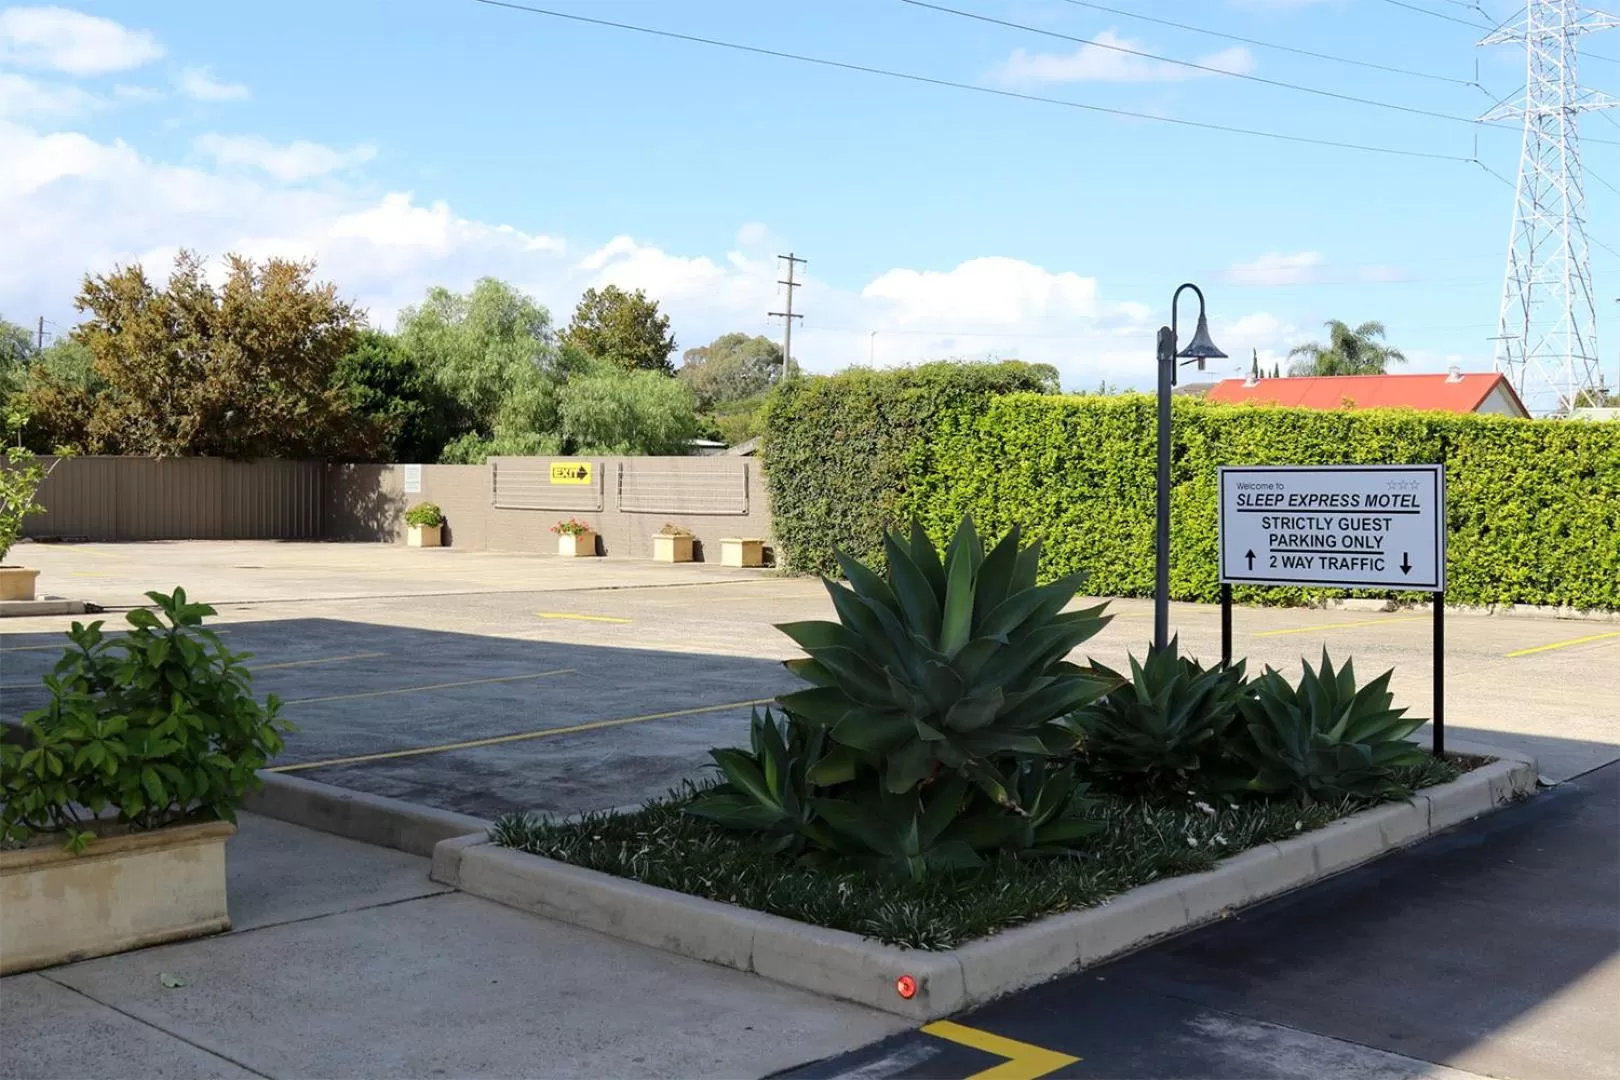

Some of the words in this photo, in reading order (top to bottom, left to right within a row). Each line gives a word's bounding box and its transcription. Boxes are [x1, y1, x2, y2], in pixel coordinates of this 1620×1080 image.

[552, 467, 578, 479] EXIT
[1236, 482, 1274, 491] Welcome
[1275, 482, 1285, 491] to
[1236, 493, 1285, 507] SLEEP
[1288, 493, 1360, 508] EXPRESS
[1364, 493, 1421, 508] MOTEL
[1261, 516, 1334, 531] STRICTLY
[1337, 516, 1393, 532] GUEST
[1269, 533, 1337, 548] PARKING
[1341, 535, 1385, 549] ONLY
[1269, 555, 1278, 569] 2
[1281, 555, 1315, 570] WAY
[1318, 556, 1386, 572] TRAFFIC
